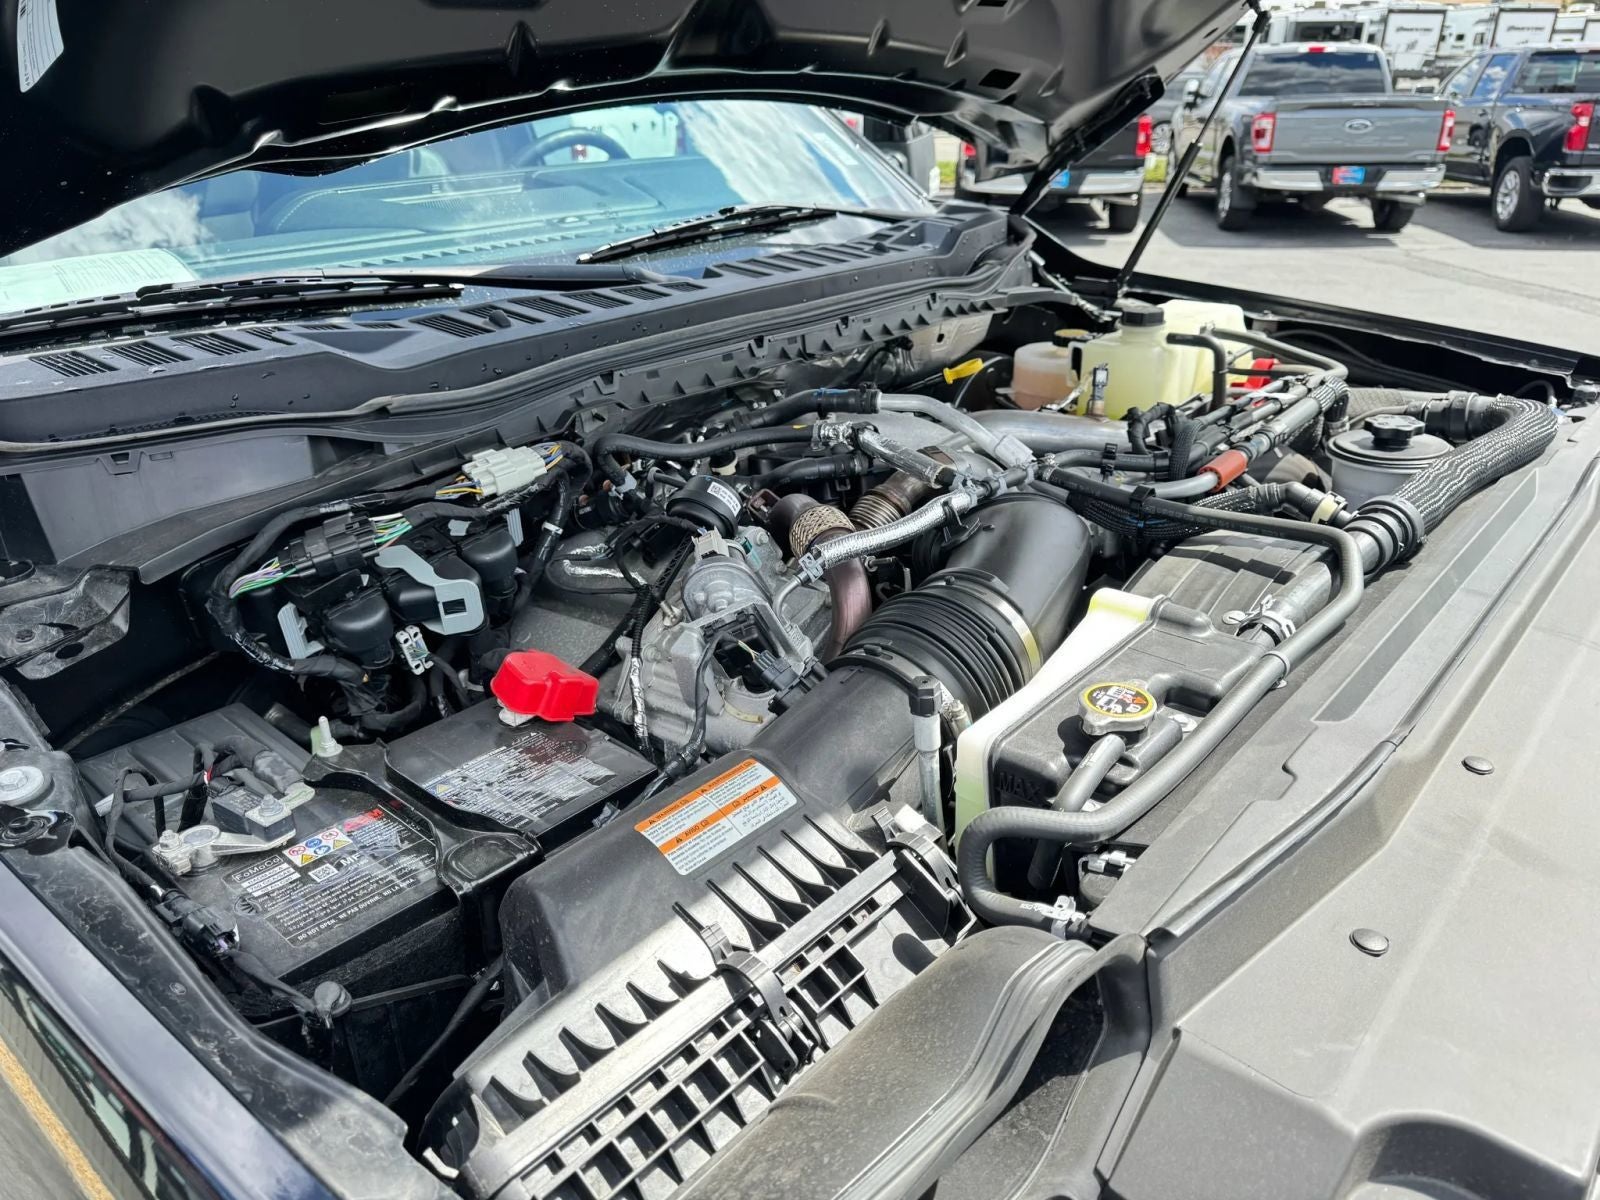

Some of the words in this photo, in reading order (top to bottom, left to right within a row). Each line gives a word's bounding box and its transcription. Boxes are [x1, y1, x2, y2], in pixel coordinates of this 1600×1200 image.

[1000, 770, 1041, 801] MAX
[684, 825, 700, 837] AVISO
[235, 858, 280, 881] FoMoCo
[307, 927, 320, 936] NOT
[347, 906, 359, 915] PAS
